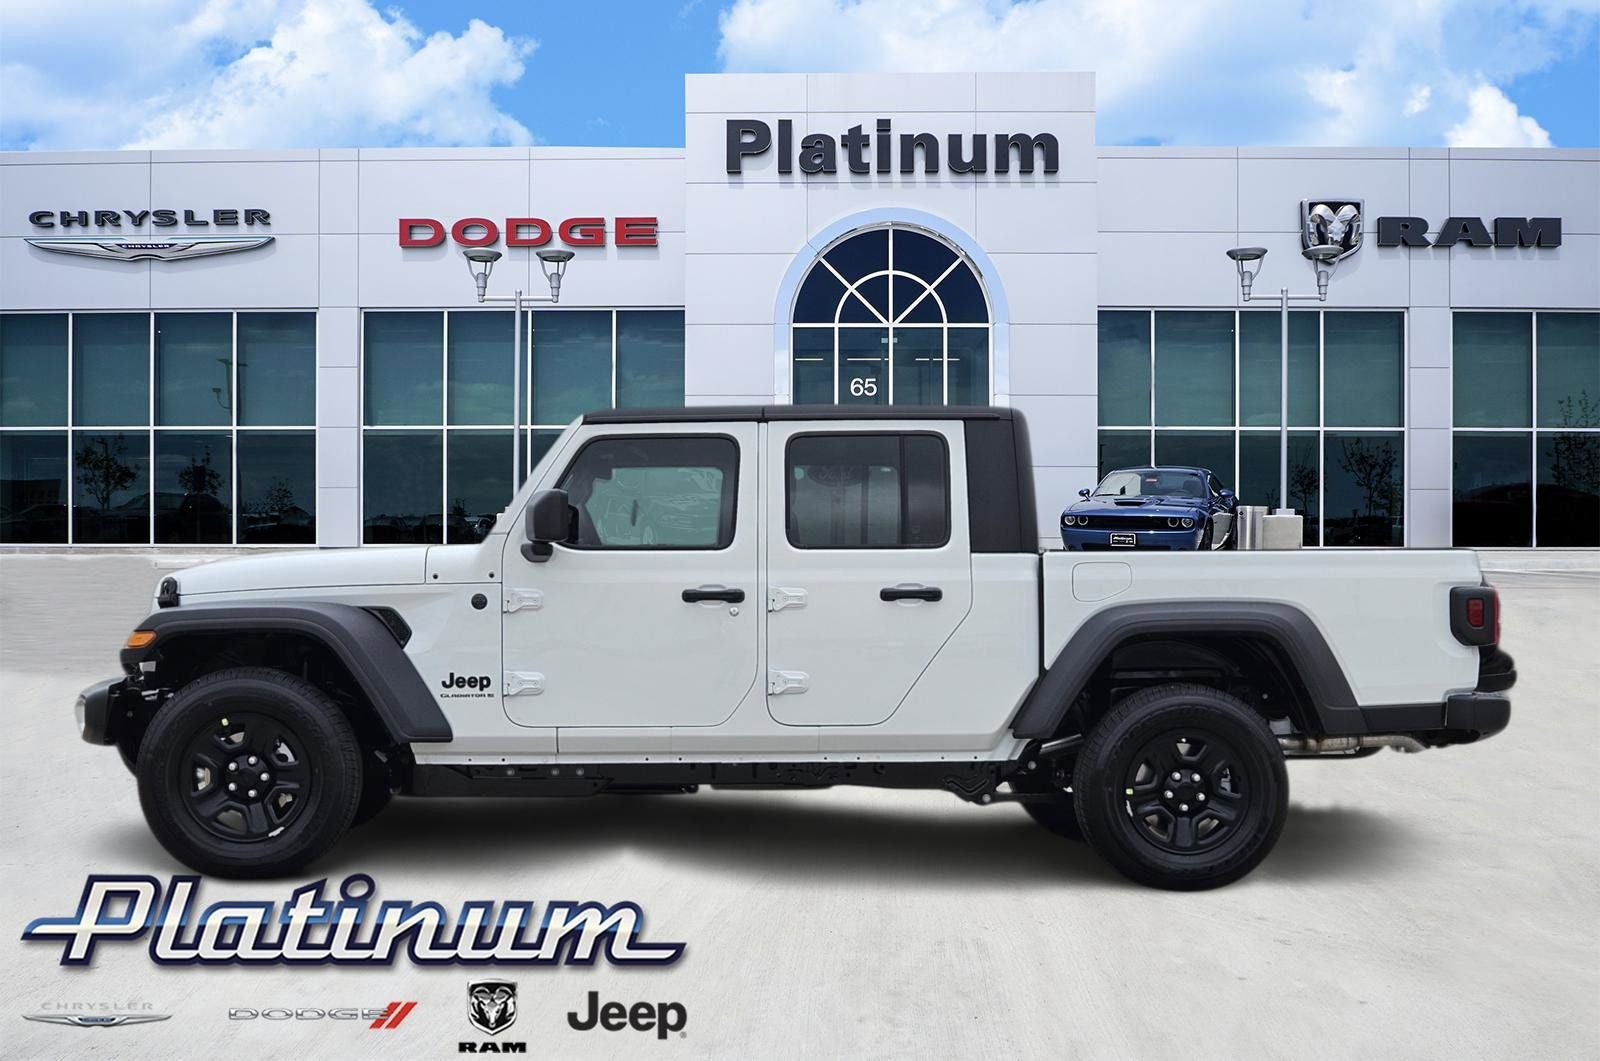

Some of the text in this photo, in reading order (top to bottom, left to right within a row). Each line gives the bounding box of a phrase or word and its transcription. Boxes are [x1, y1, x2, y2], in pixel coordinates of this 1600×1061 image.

[725, 118, 1060, 175] Platinum
[28, 208, 272, 229] CHRYSLER
[399, 217, 659, 248] DODGE
[1376, 216, 1562, 249] RAM
[849, 377, 878, 397] 65
[441, 671, 491, 692] Jeep
